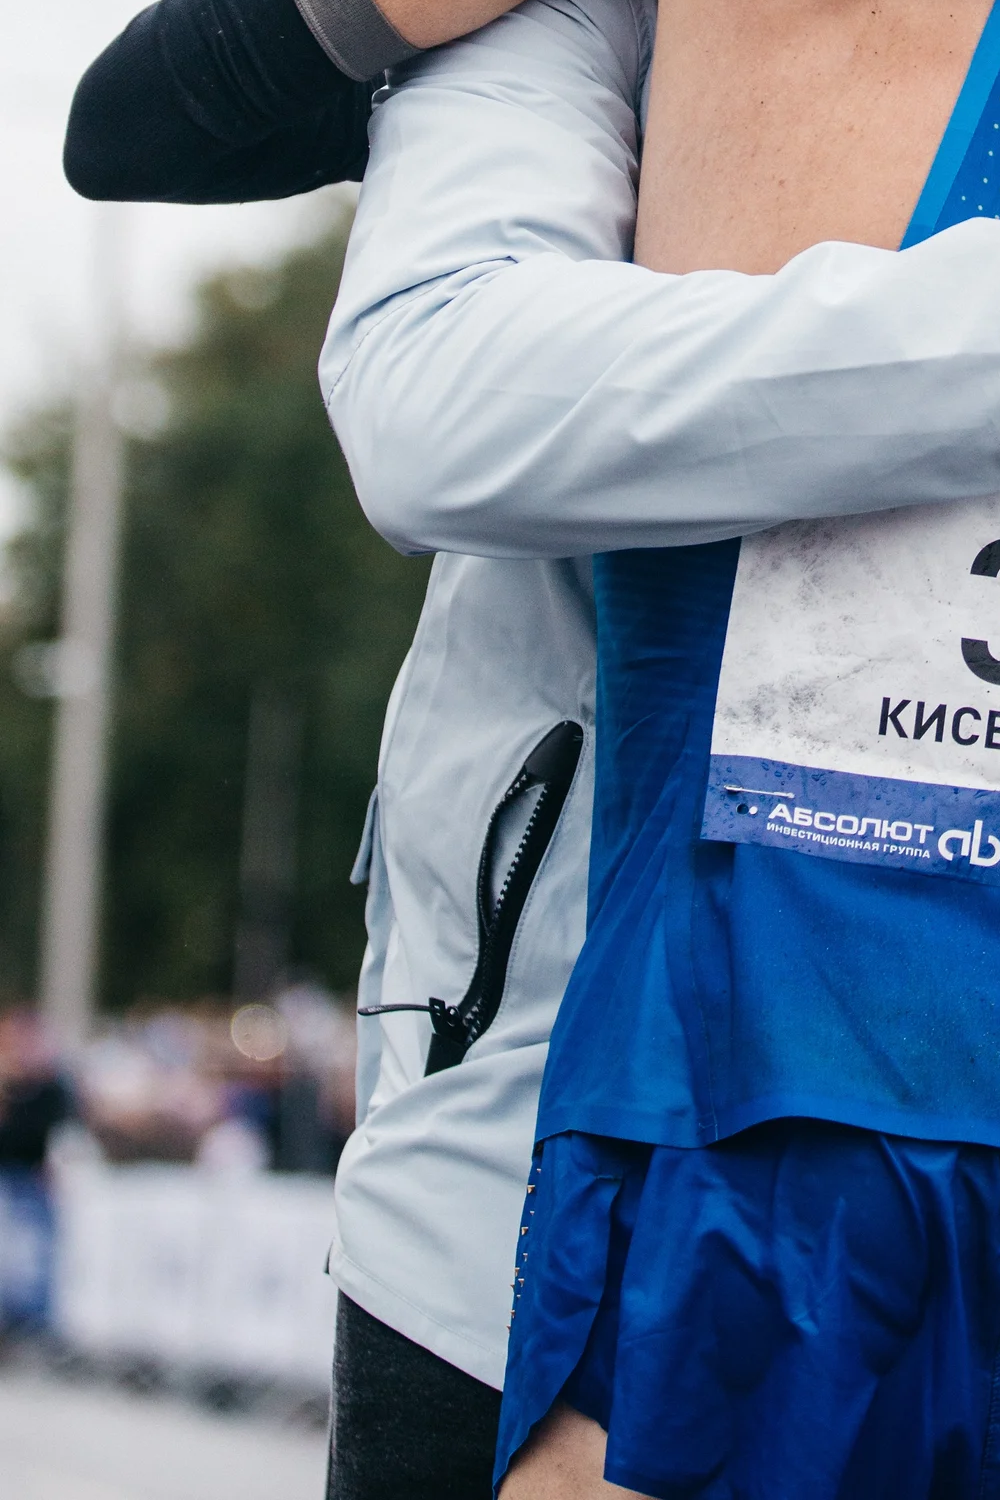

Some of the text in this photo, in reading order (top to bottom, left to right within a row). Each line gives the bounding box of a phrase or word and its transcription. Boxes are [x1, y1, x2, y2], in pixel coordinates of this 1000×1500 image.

[765, 821, 931, 859] ИНВЕСТИЦИОННАЯ ГРУППА
[767, 803, 934, 844] АБСОЛЮТ
